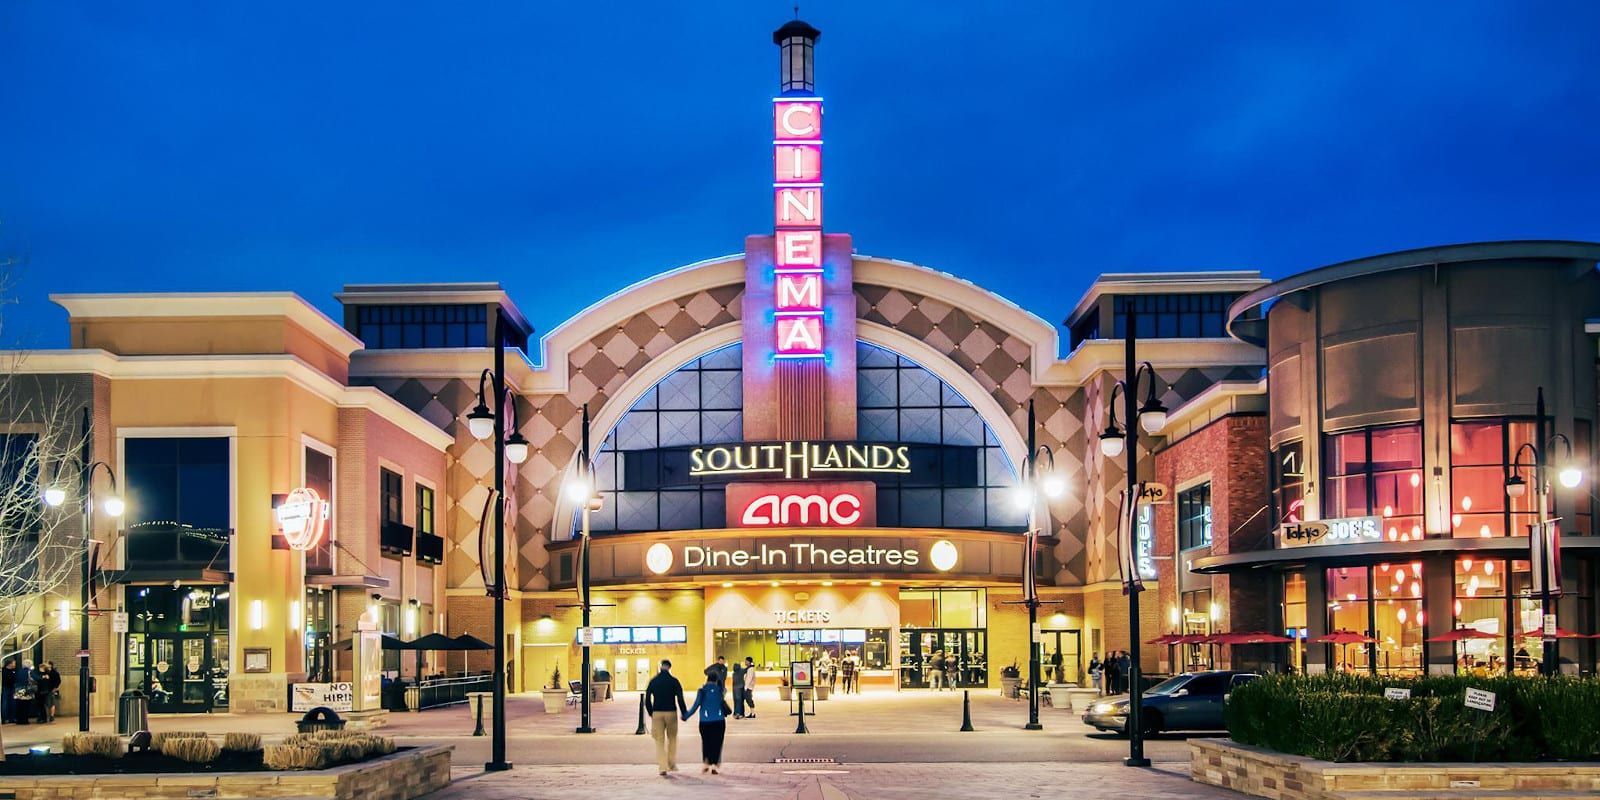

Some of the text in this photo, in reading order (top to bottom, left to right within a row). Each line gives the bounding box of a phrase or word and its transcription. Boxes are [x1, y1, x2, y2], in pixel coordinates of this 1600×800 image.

[782, 105, 818, 350] CINEMA
[690, 442, 911, 478] SOUTHLANDS
[1141, 479, 1163, 502] kyo
[742, 493, 861, 525] amc
[1284, 524, 1320, 543] Tokyo
[684, 543, 919, 567] Dine-In Theatres
[774, 610, 831, 624] TICKETS
[620, 647, 647, 655] TICKETS
